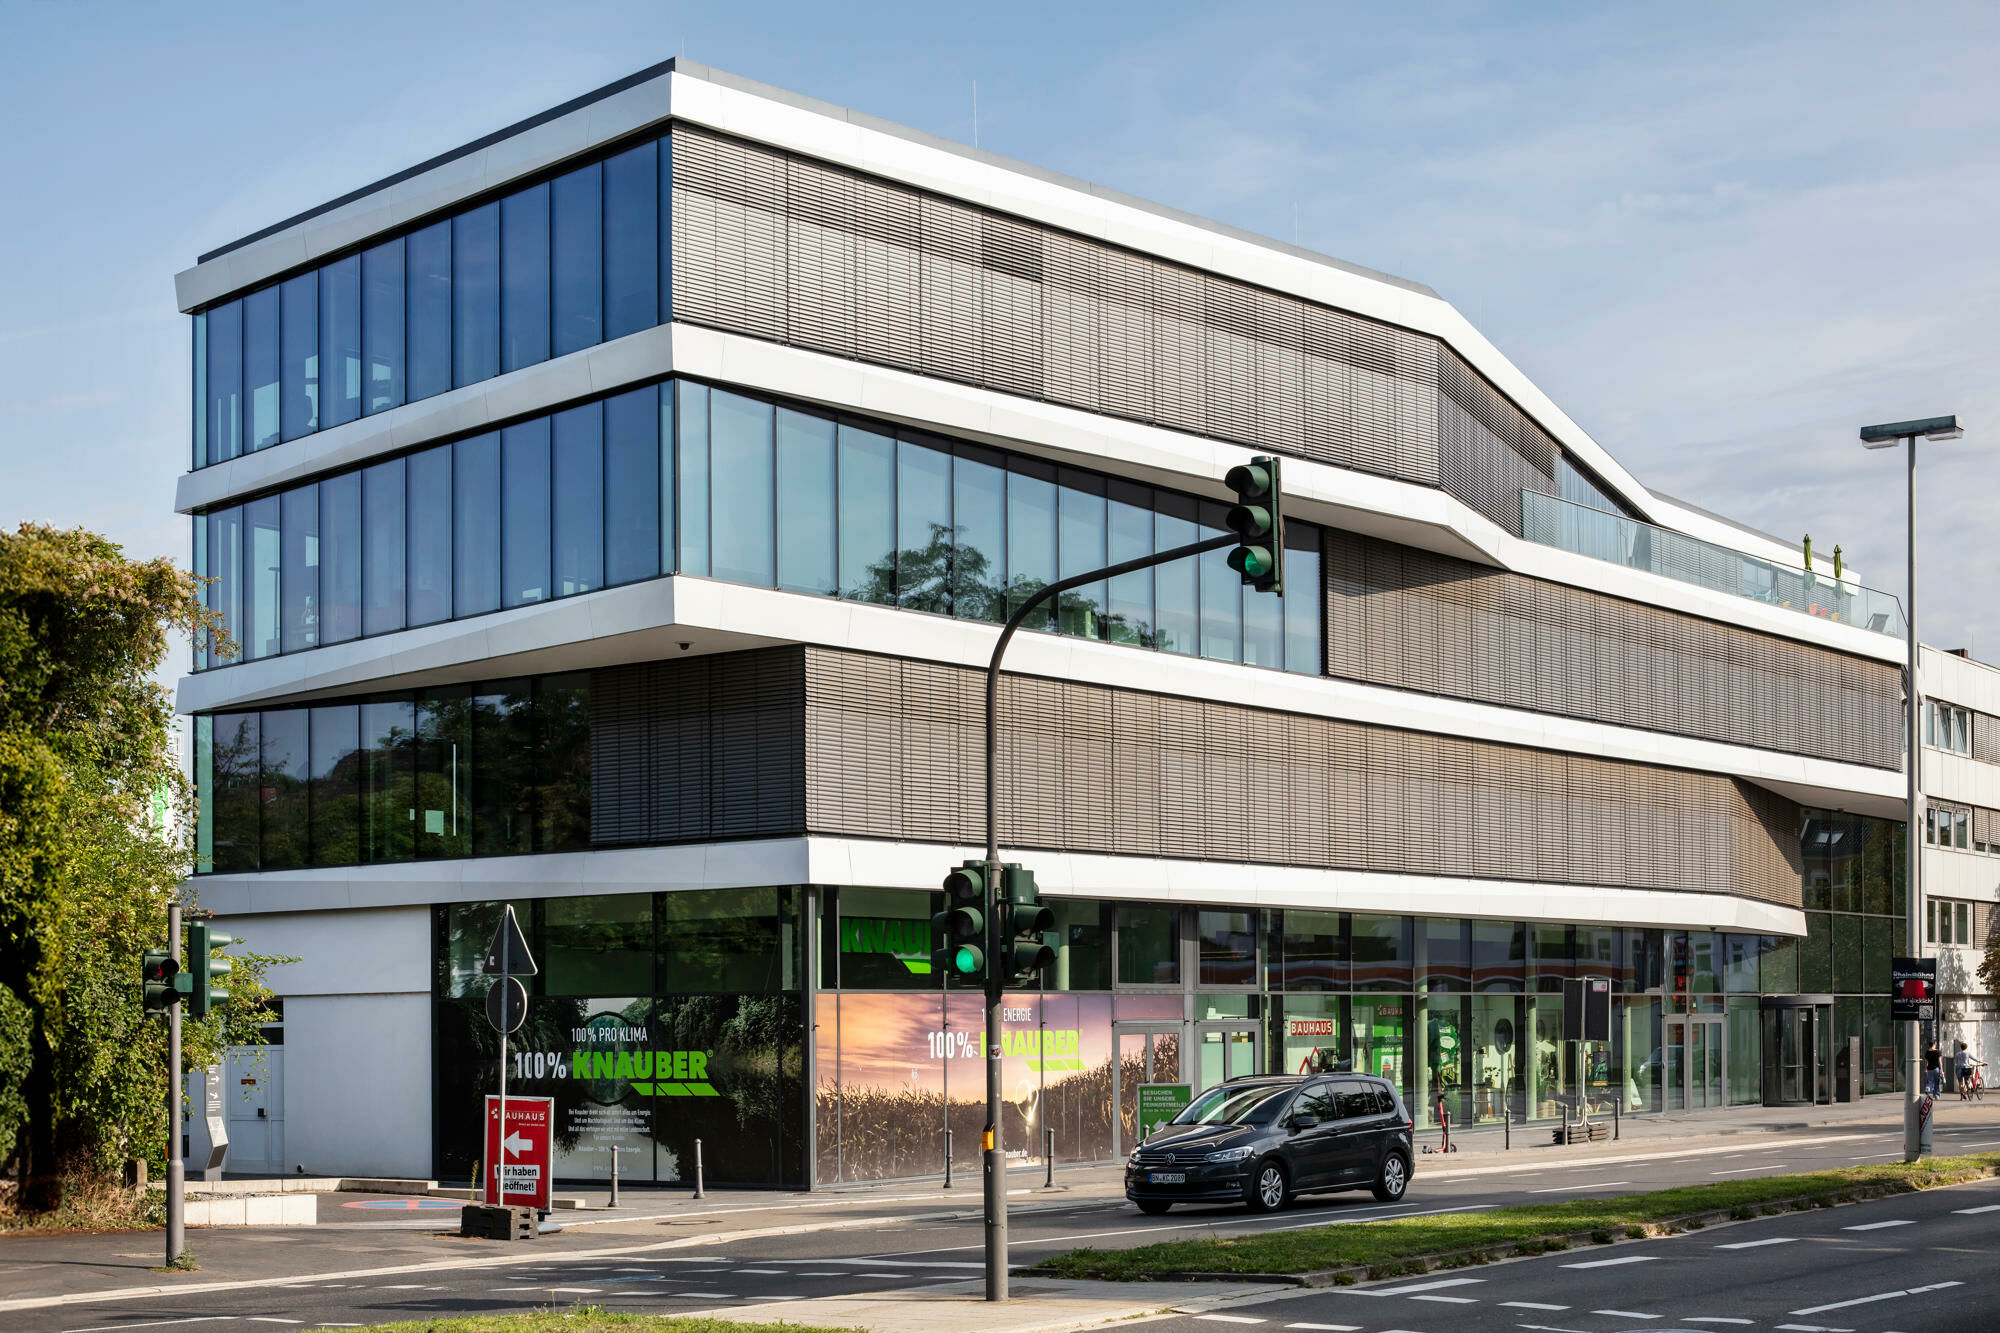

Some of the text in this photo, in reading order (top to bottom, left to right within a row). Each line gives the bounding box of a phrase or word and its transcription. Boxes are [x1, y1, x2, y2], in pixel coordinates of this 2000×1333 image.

[840, 918, 931, 955] KNAU
[1003, 1007, 1032, 1022] ENERGIE
[598, 1027, 617, 1042] PRO
[619, 1026, 648, 1042] KLIMA
[1291, 1022, 1333, 1034] BAUHAUS
[504, 1111, 545, 1121] AUHAUS
[512, 1166, 537, 1177] haben
[502, 1180, 535, 1192] eöffnet!
